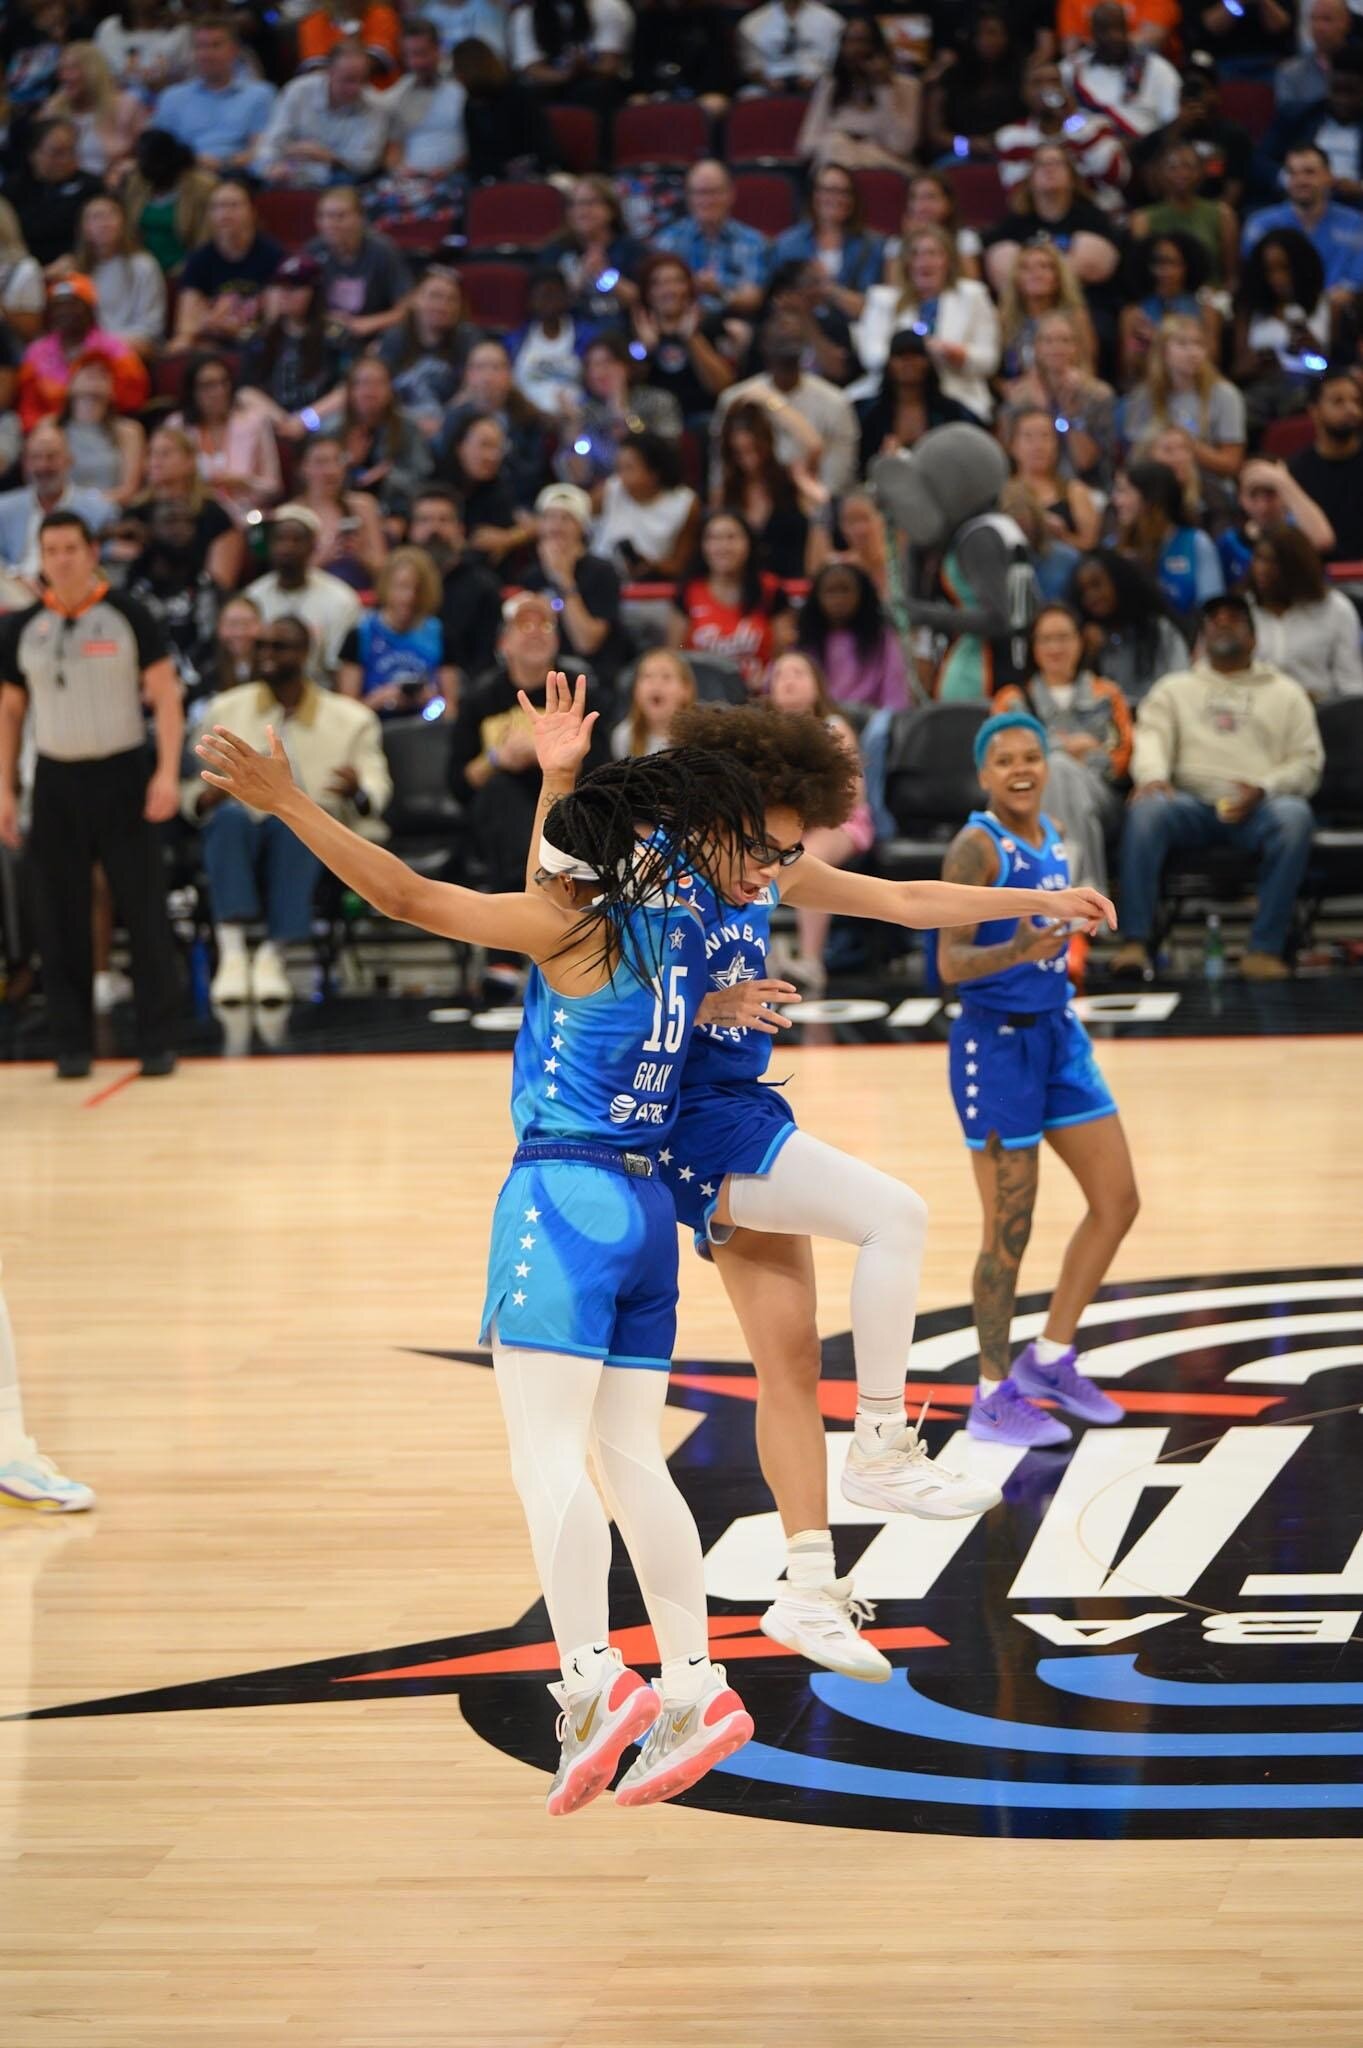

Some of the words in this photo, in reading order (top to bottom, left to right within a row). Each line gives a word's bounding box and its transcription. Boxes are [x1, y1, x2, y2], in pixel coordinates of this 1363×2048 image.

[705, 924, 766, 960] WNBA
[642, 965, 688, 1053] 15
[633, 1061, 673, 1093] GRAY
